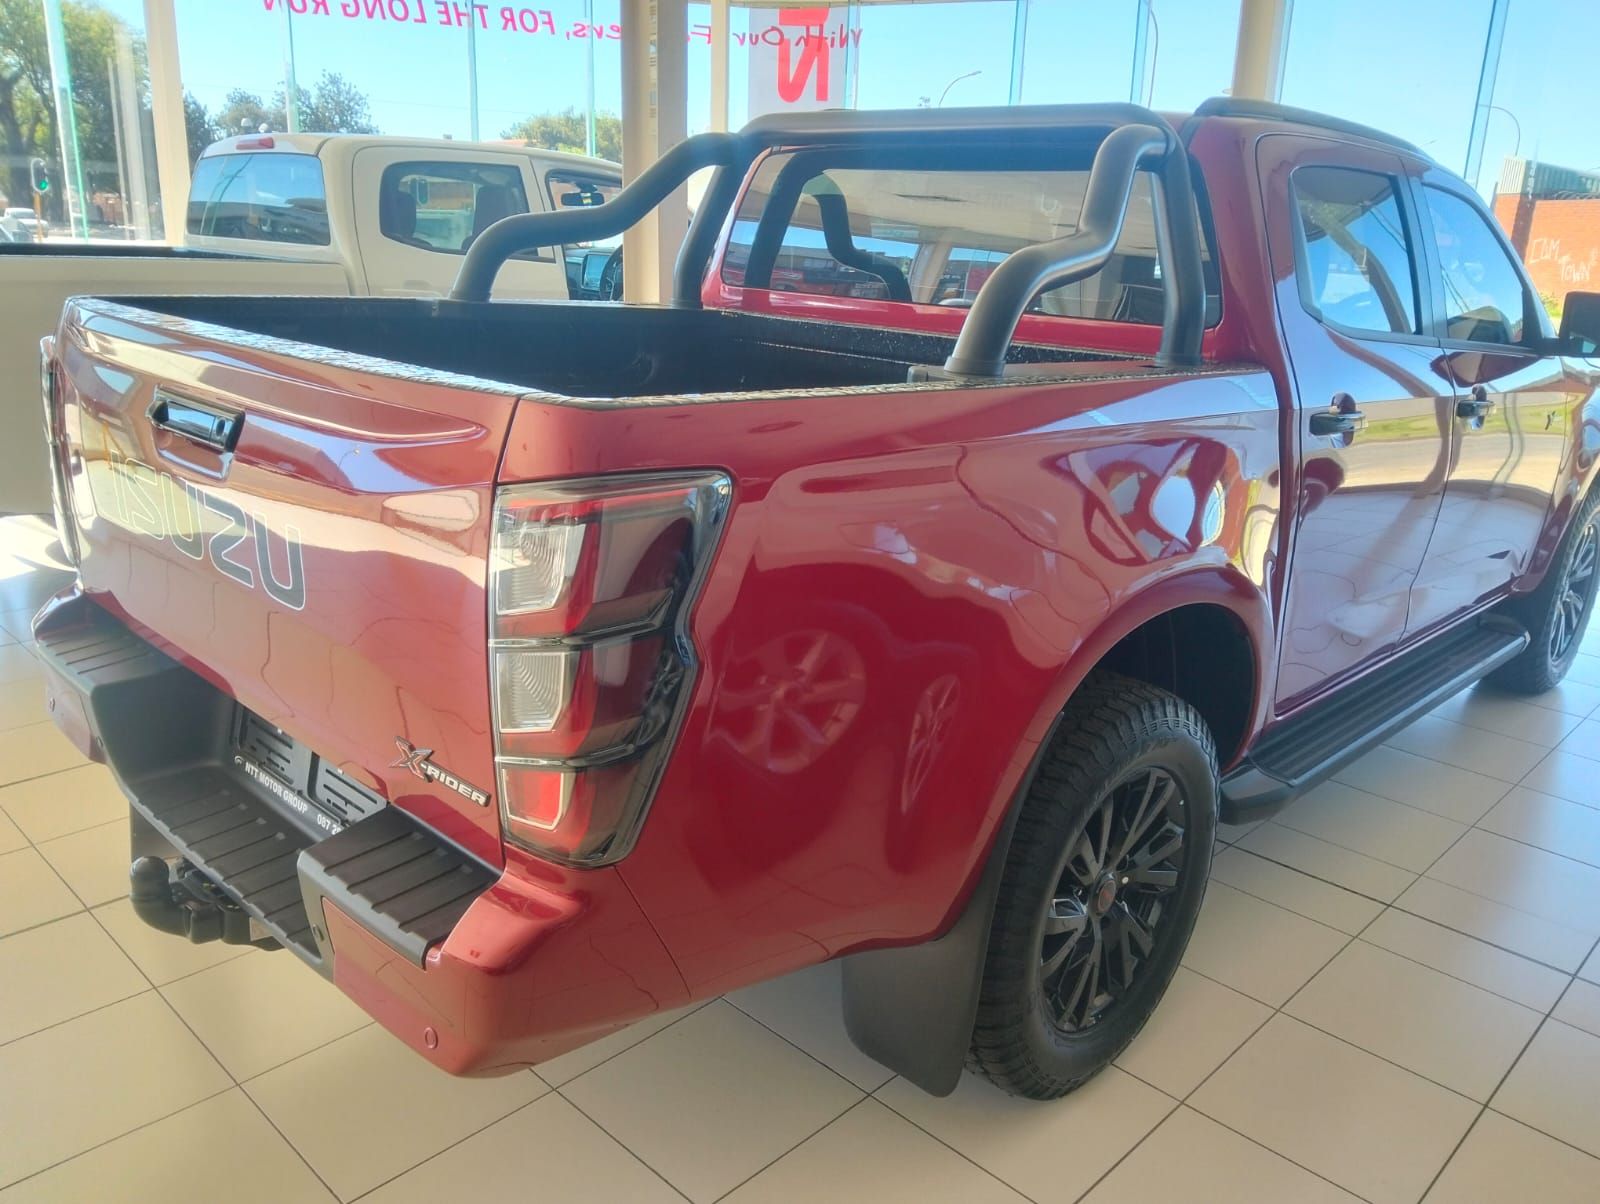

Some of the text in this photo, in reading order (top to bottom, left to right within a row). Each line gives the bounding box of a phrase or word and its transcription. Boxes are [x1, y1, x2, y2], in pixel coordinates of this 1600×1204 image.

[110, 449, 306, 611] ISUZU
[244, 761, 259, 778] NTT
[258, 771, 283, 797] MOTOR
[282, 789, 309, 815] GROUP
[316, 813, 331, 831] 087
[388, 734, 491, 807] X-RIDER
